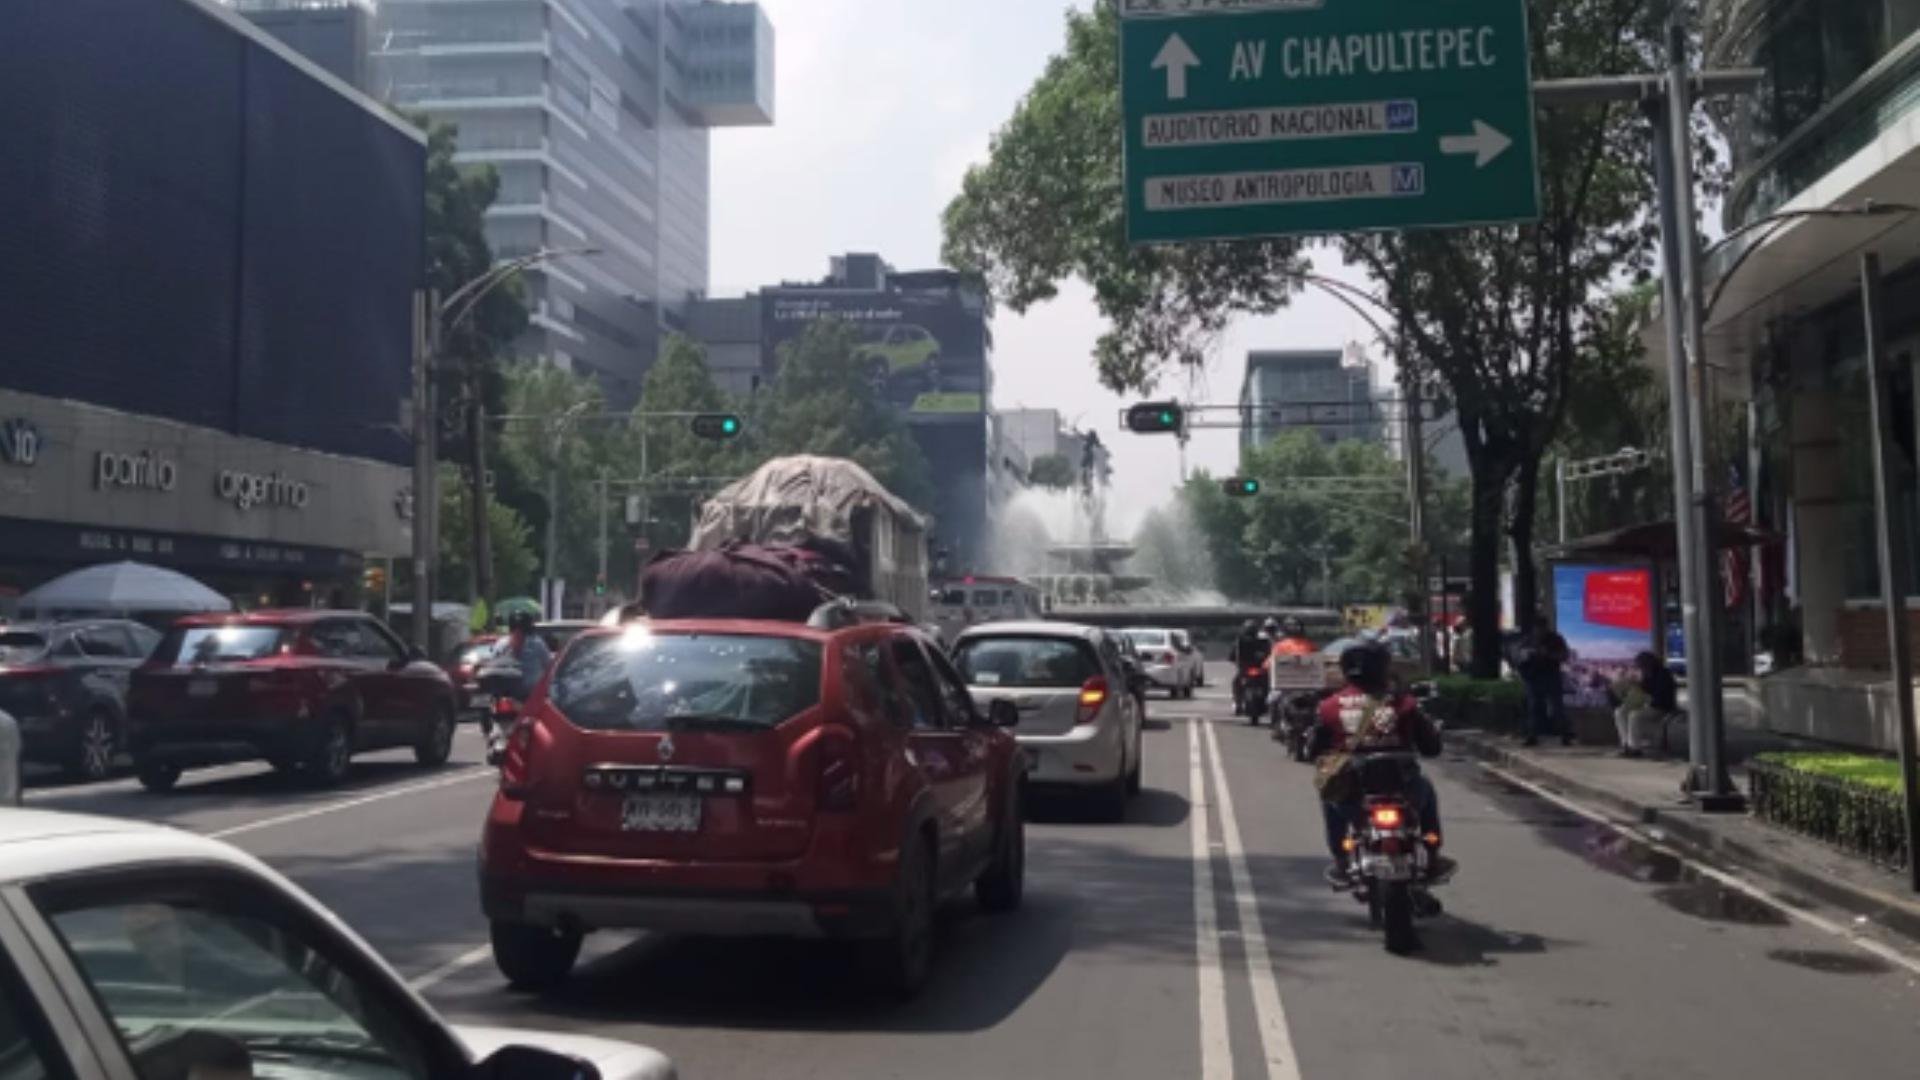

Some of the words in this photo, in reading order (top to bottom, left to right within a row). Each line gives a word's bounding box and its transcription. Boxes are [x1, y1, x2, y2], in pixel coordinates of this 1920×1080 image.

[1229, 39, 1267, 80] AV
[1282, 26, 1497, 79] CHAPULTEPEC
[1147, 113, 1259, 143] AUDITORIO
[1270, 107, 1382, 136] NACIONAL
[1161, 178, 1224, 206] MUSEO
